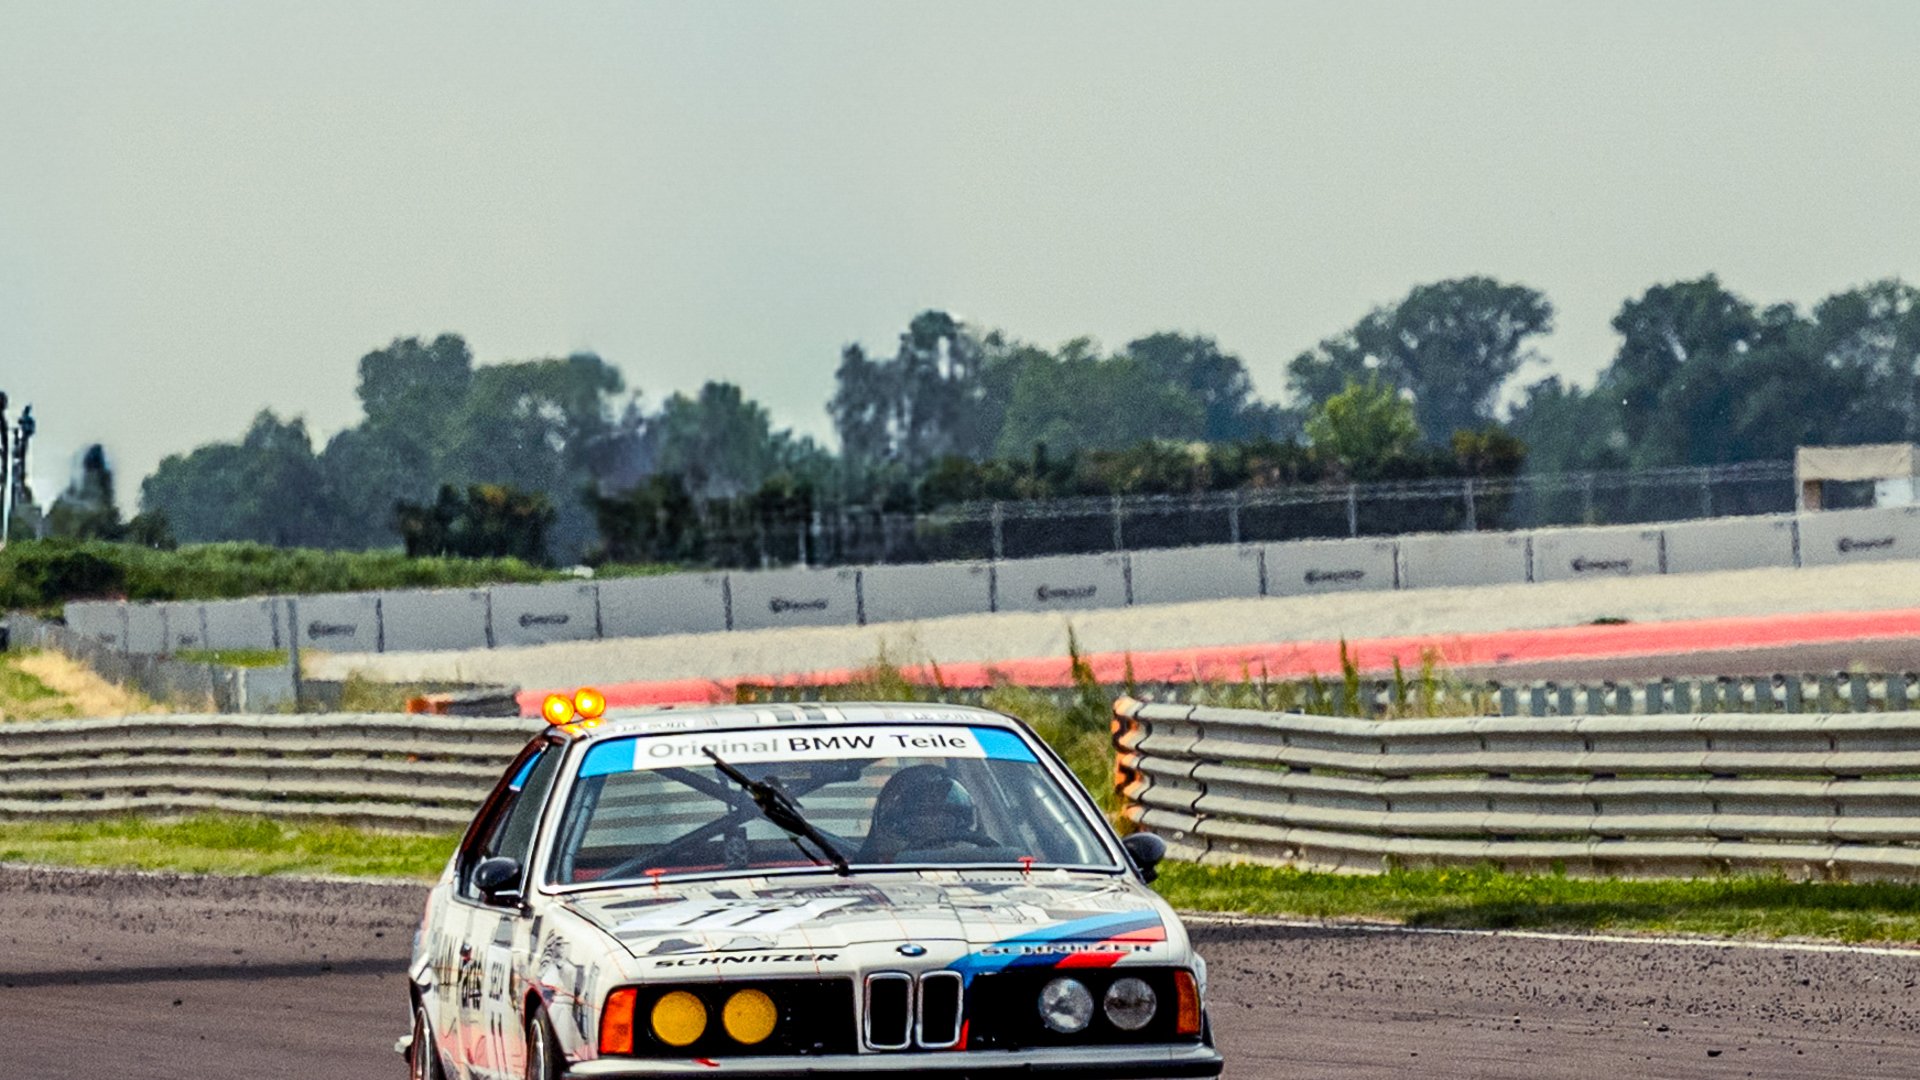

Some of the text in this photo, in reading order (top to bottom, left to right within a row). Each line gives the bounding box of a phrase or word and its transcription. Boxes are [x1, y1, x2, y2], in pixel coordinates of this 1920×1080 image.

[788, 734, 875, 752] BMW
[890, 733, 967, 749] Teile
[654, 953, 839, 969] SCHNITZER
